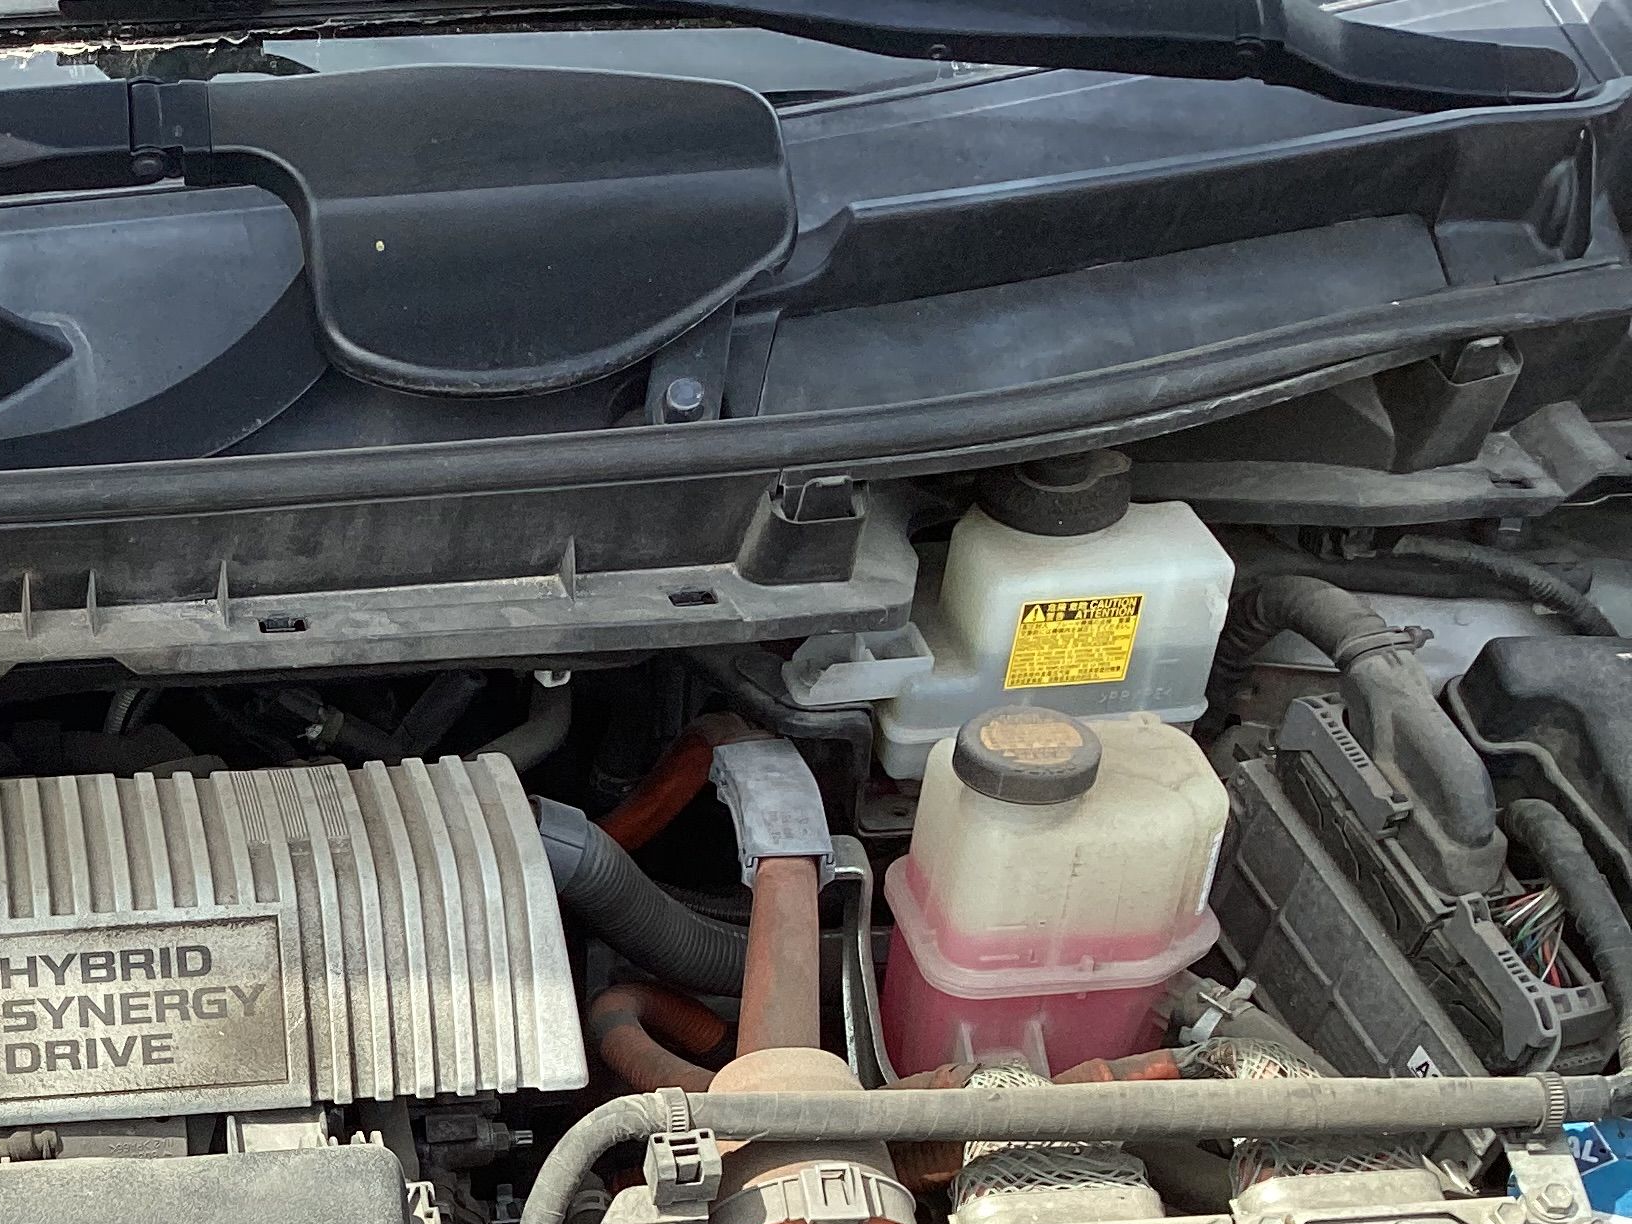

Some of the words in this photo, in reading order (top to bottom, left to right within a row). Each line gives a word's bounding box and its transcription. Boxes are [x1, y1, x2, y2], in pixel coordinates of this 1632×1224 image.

[1074, 607, 1134, 620] ATTENTION
[1090, 598, 1137, 611] CAUTION
[0, 944, 213, 990] HYBRID
[3, 984, 266, 1034] SYNERGY
[5, 1032, 175, 1075] DRIVE
